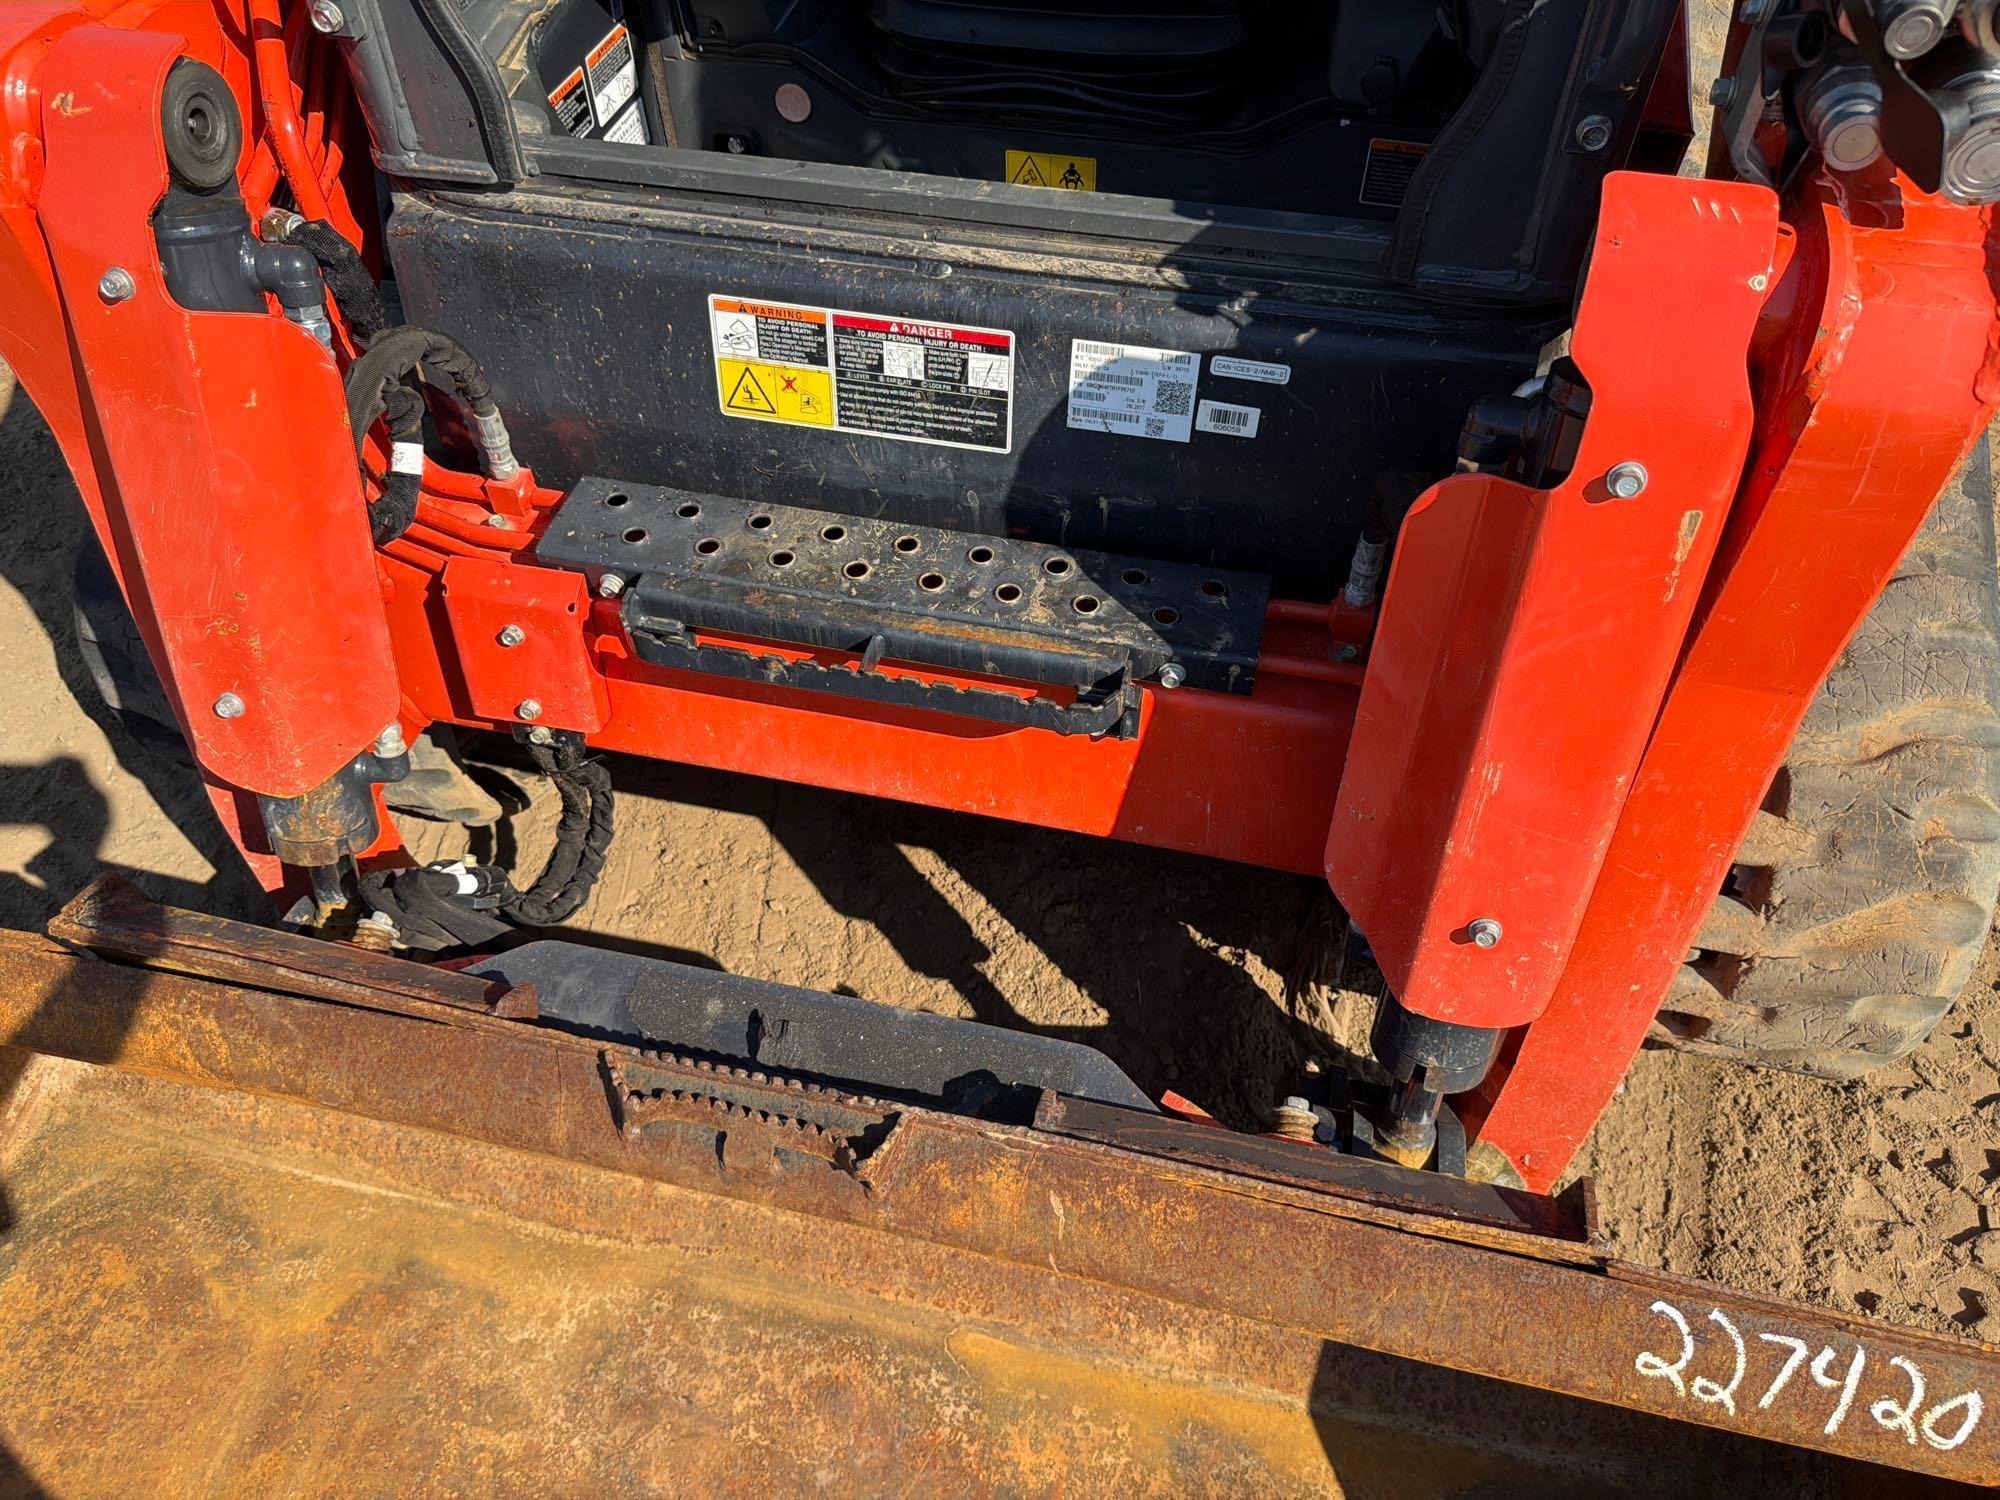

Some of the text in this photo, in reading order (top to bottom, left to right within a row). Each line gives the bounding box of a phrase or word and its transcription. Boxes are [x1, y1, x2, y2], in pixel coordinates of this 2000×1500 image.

[750, 306, 803, 320] WARNING
[758, 323, 780, 331] INJURY
[787, 321, 820, 330] PERSONAL
[902, 325, 952, 339] DANGER
[867, 332, 887, 341] AVOID
[888, 334, 923, 345] PERSONAL
[924, 339, 947, 348] INJURY
[949, 342, 958, 350] OR
[1635, 1300, 1984, 1450] 227420
